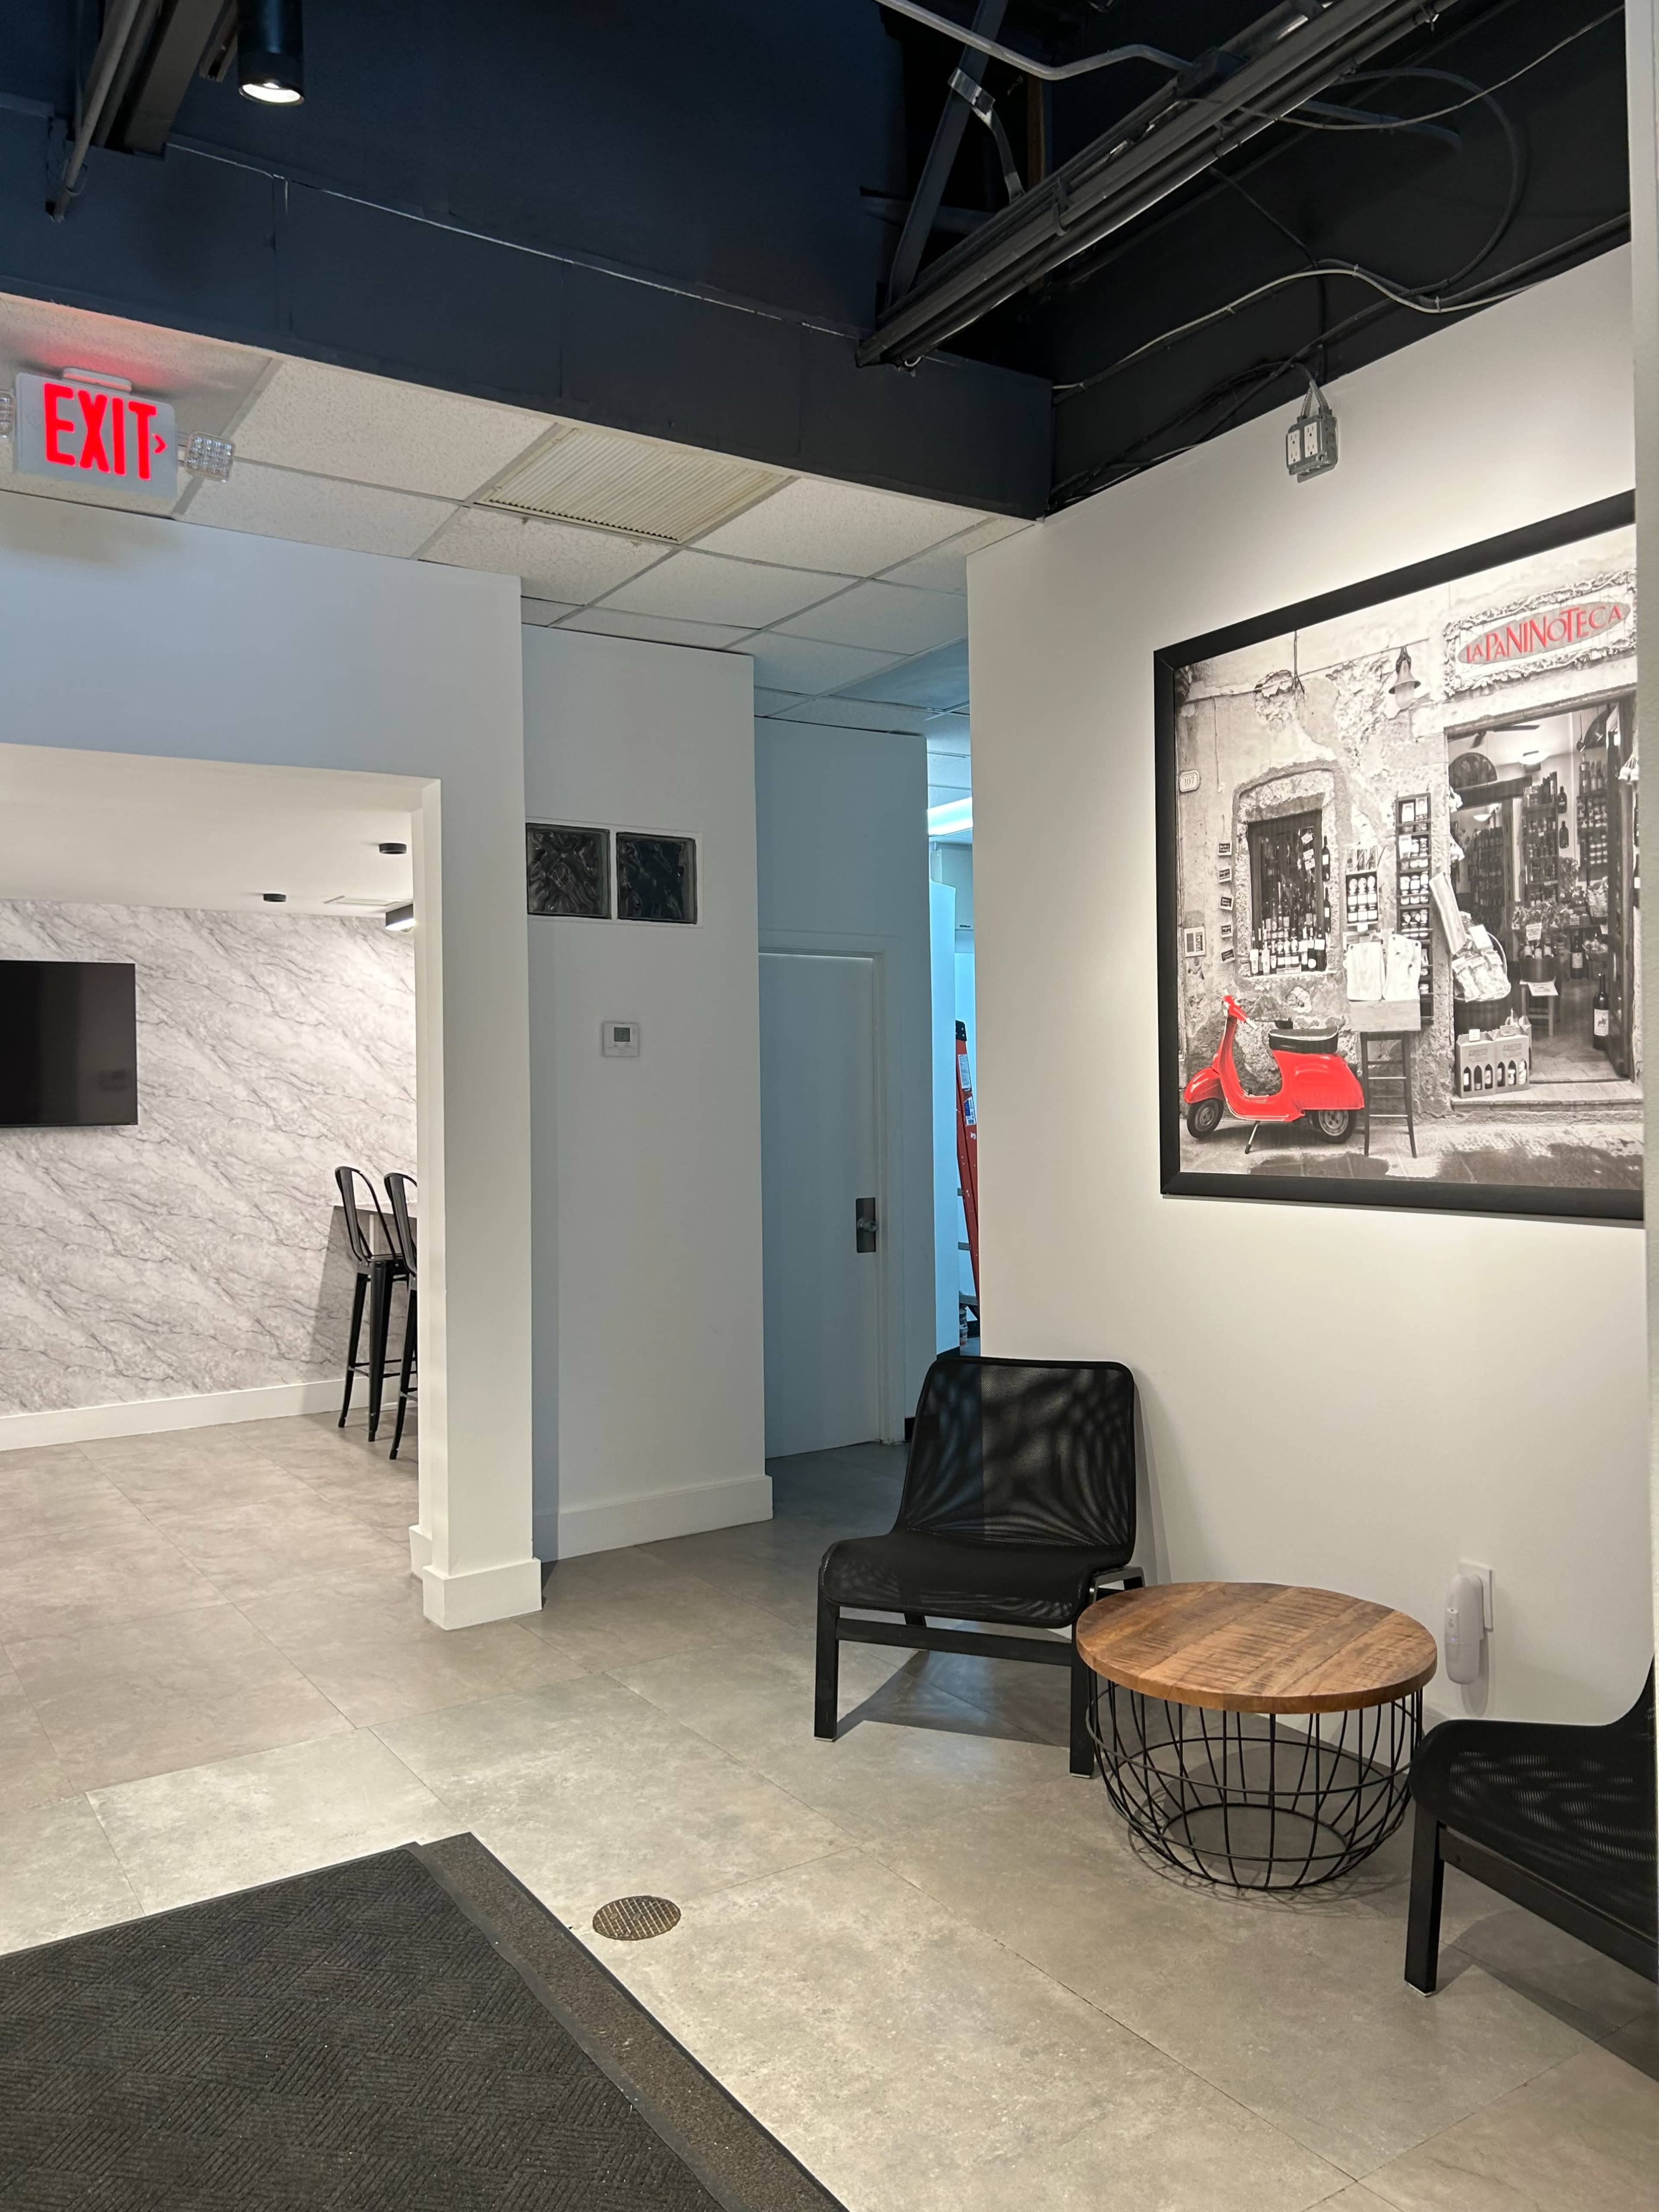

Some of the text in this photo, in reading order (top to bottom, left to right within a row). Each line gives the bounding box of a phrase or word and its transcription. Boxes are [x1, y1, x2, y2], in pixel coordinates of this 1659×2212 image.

[43, 382, 157, 480] EXIT
[1466, 605, 1623, 663] LA PANINOTECA
[1185, 776, 1194, 786] 107
